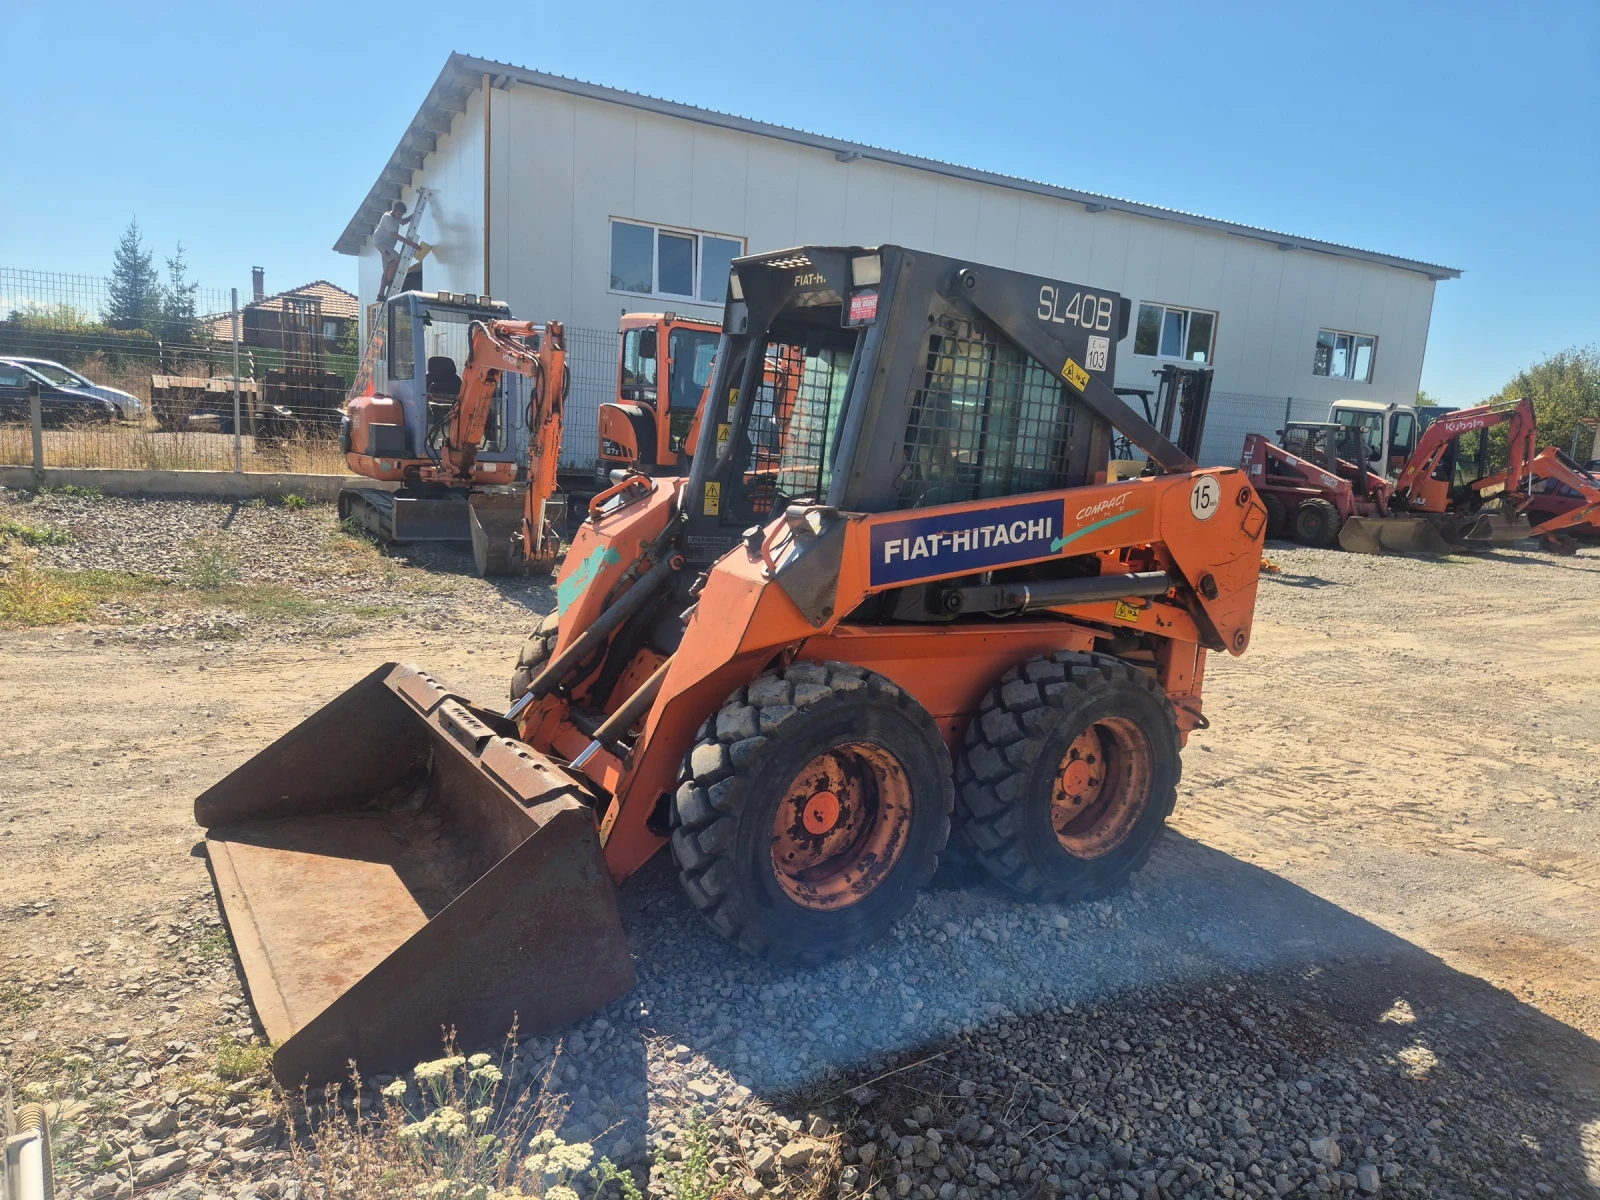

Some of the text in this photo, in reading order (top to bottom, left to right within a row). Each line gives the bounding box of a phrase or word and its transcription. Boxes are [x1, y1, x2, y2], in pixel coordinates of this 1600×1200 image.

[1037, 285, 1113, 332] SL40B
[1088, 350, 1105, 369] 103
[1445, 419, 1484, 431] Kubota
[1076, 490, 1133, 520] COMPACT
[1194, 484, 1211, 510] 15
[884, 516, 1053, 565] FIAT-HITACHI
